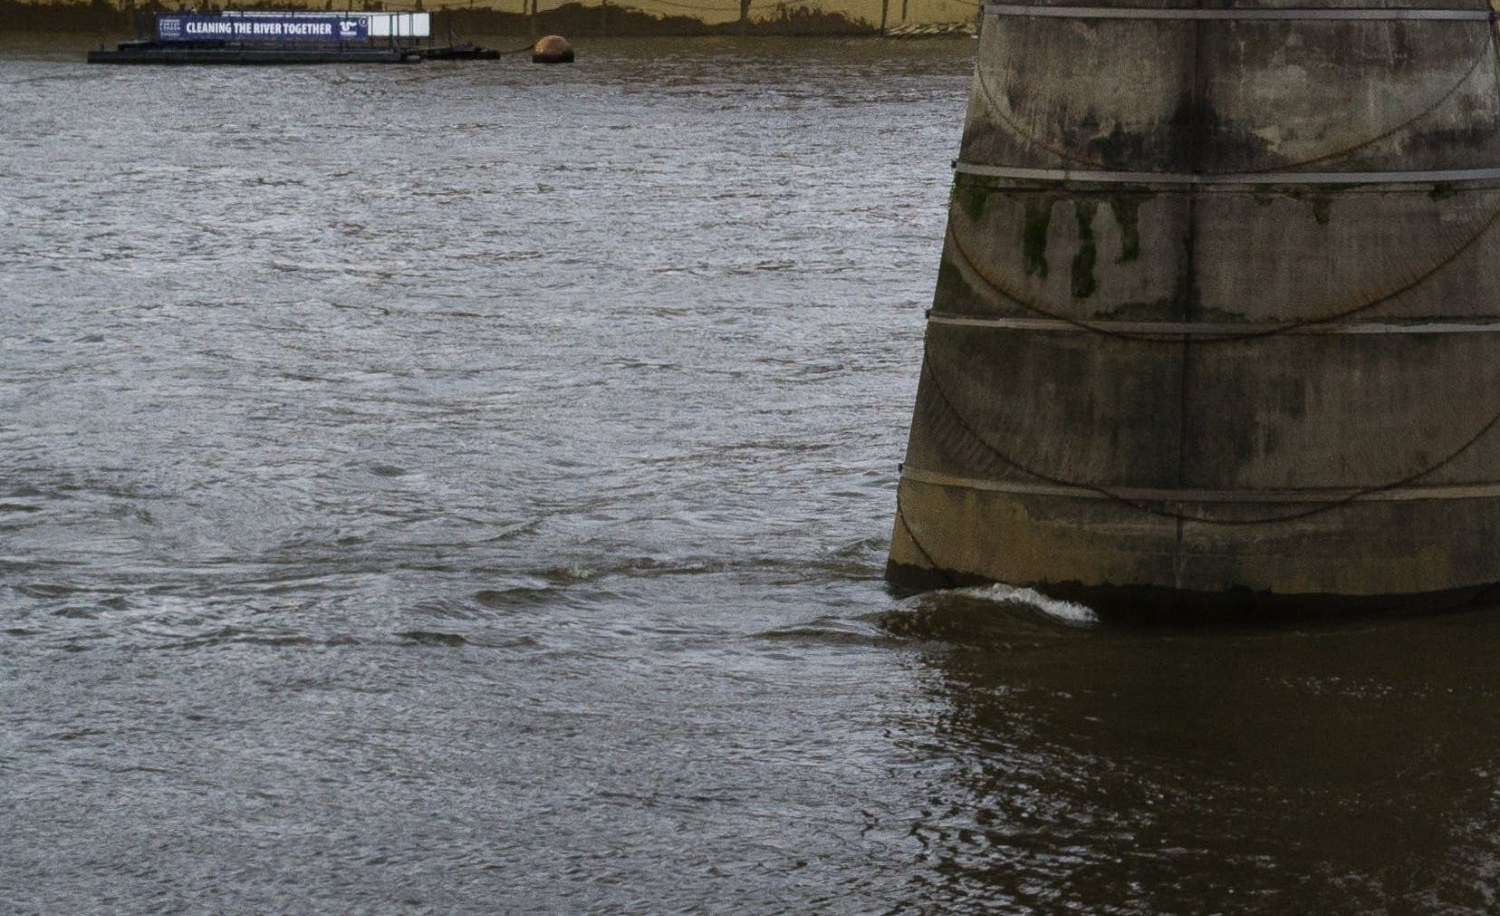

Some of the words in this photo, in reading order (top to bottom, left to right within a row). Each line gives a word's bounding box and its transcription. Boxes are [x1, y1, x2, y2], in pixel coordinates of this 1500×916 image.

[186, 22, 231, 33] CLEANING
[233, 23, 251, 34] THE
[254, 23, 281, 34] RIVER
[283, 23, 332, 34] TOGETHER
